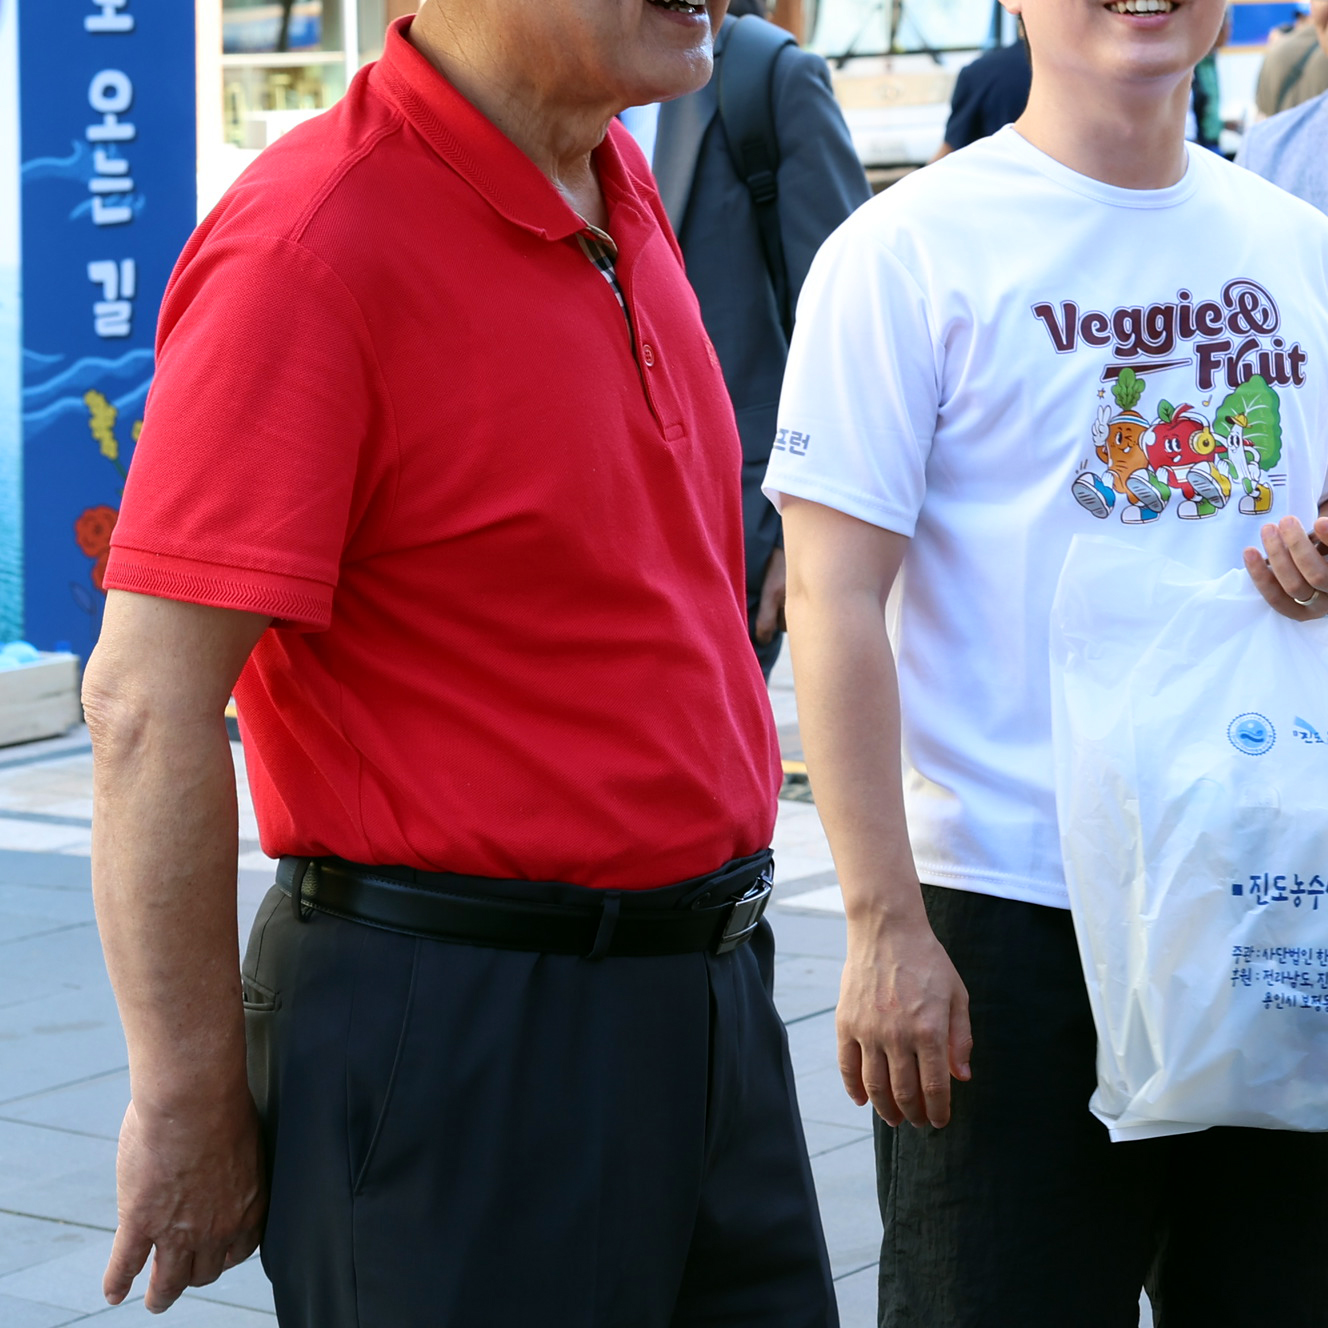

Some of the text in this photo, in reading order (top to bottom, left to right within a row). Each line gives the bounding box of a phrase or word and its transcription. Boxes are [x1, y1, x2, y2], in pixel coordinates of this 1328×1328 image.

[86, 68, 137, 226] 오는
[87, 257, 136, 338] 길
[1194, 336, 1308, 393] Fruit
